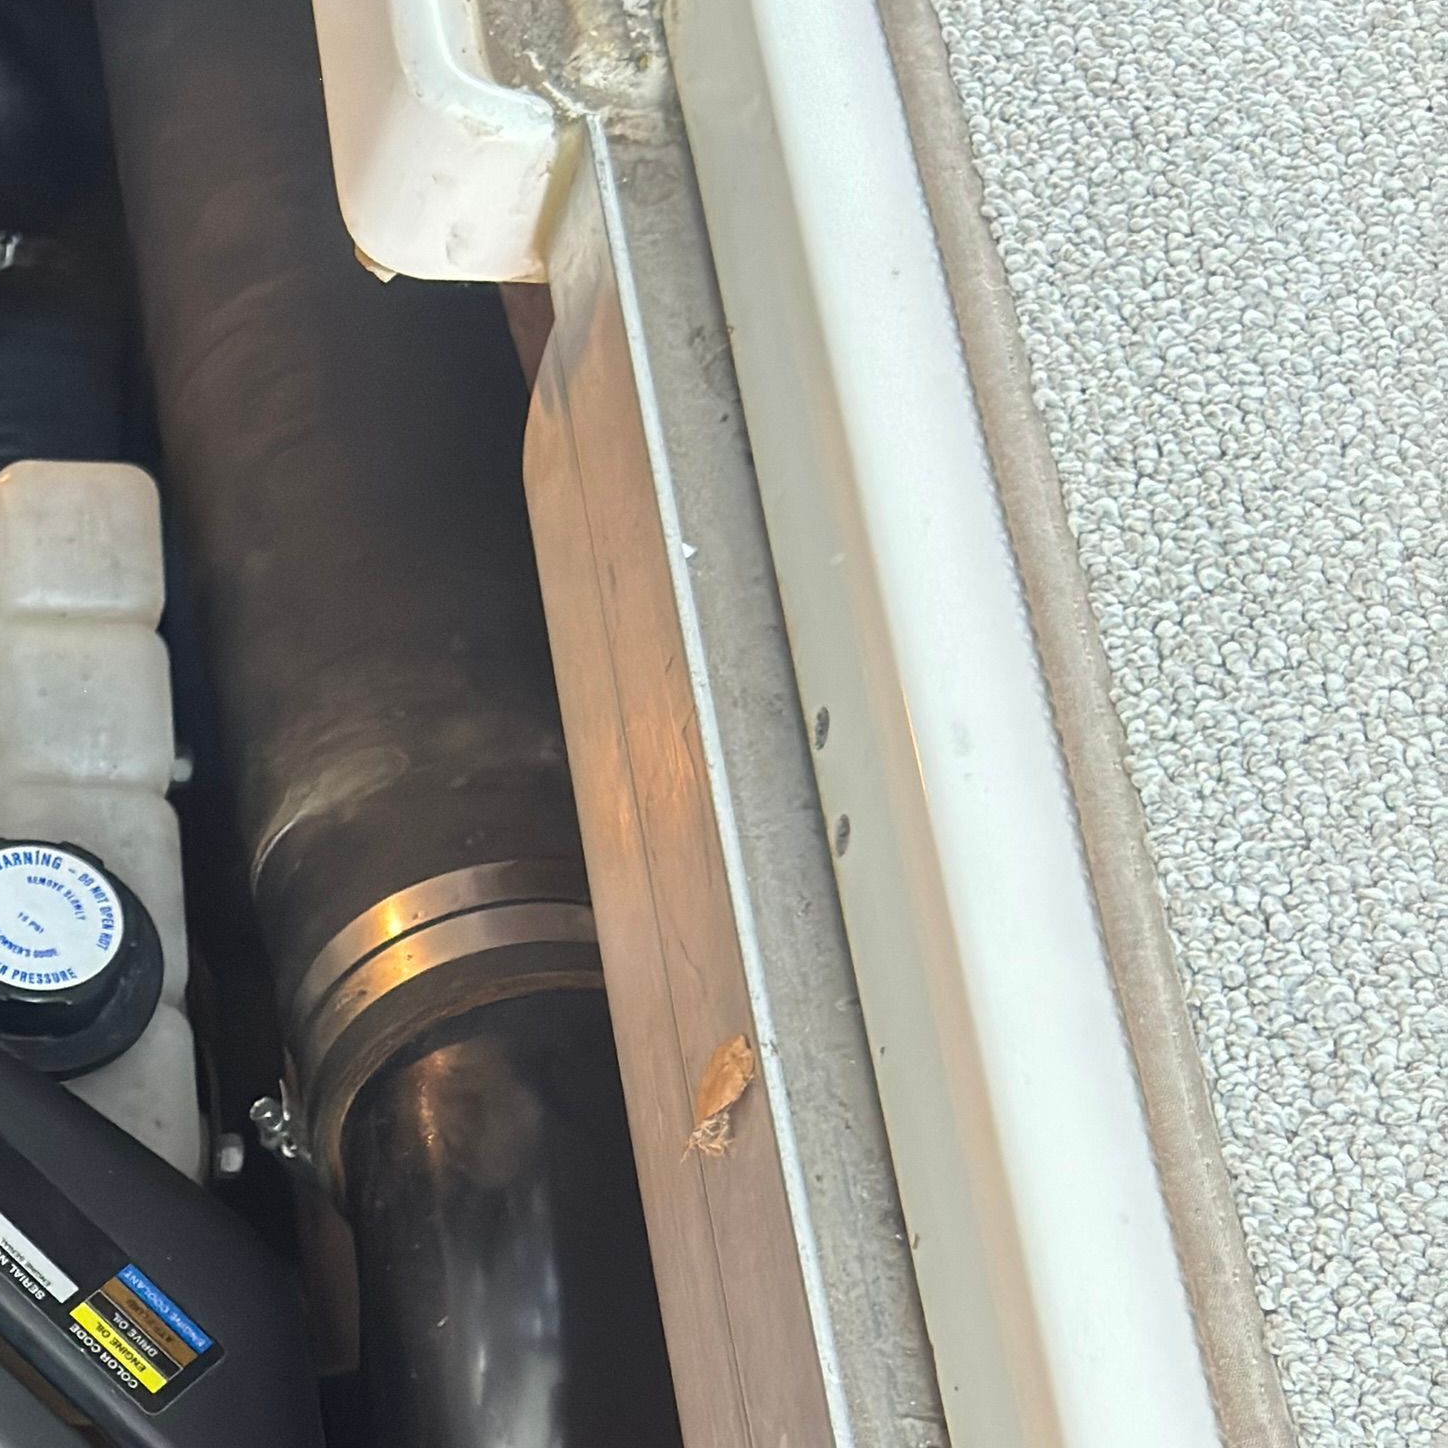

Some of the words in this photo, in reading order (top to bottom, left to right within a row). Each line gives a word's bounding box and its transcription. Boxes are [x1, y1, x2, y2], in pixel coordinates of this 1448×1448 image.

[26, 876, 64, 891] REMOVE
[77, 873, 94, 886] DO
[89, 885, 108, 903] NOT
[99, 906, 114, 929] OPEN
[96, 932, 114, 951] HOT
[11, 966, 77, 983] PRESSURE
[6, 1262, 46, 1300] SERIAL
[122, 1268, 171, 1315] COOLANT
[92, 1321, 111, 1339] OIL
[110, 1311, 129, 1331] OIL
[166, 1309, 207, 1348] ENGINE
[68, 1321, 102, 1354] CODE
[126, 1326, 158, 1358] DRIVE
[108, 1336, 147, 1373] ENGINE
[98, 1351, 139, 1390] COLOR
